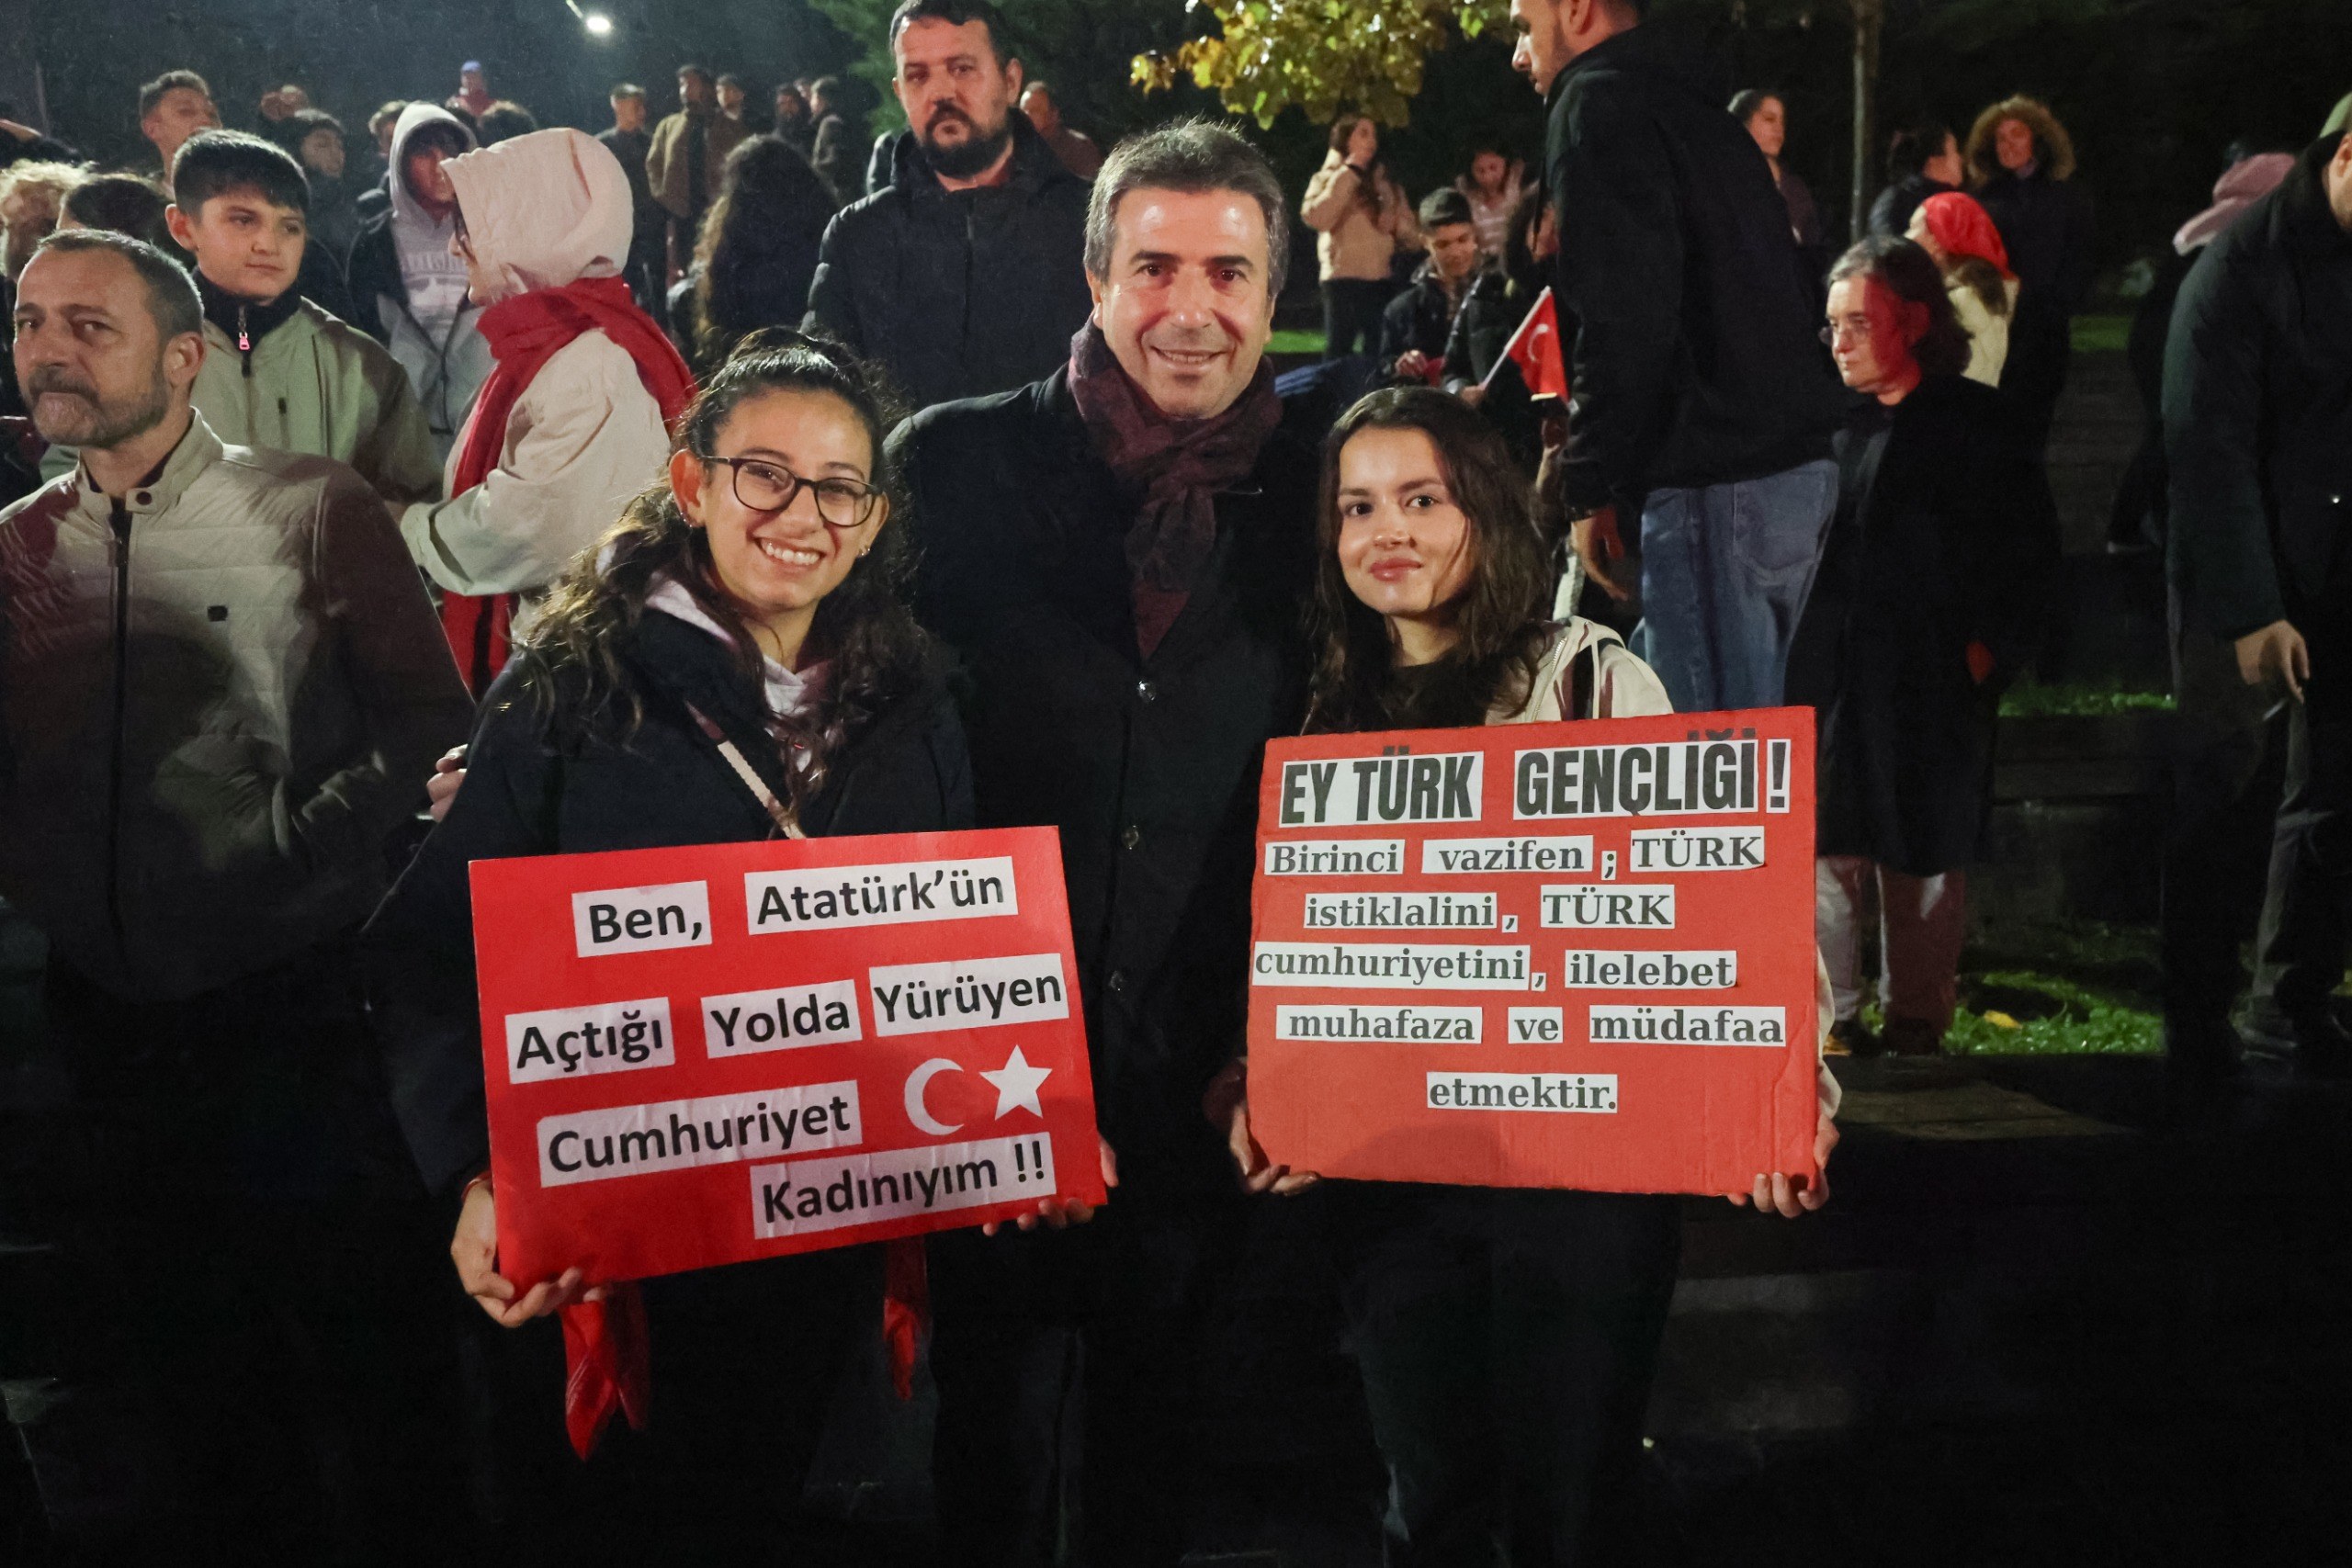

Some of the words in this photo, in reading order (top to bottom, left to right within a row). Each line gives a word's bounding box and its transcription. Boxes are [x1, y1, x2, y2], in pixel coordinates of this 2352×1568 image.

[1281, 762, 1338, 825] EY
[1352, 745, 1476, 823] TÜRK
[1271, 843, 1398, 874] Birinci
[1438, 840, 1585, 871] vazifen
[1632, 829, 1762, 868] TÜRK
[589, 903, 703, 944] Ben,
[757, 870, 1004, 925] Atatürk’ün
[1543, 886, 1672, 925] TÜRK
[1570, 953, 1734, 987] ilelebet
[515, 1008, 664, 1073] Açtığı
[709, 992, 851, 1047] Yolda
[873, 972, 1061, 1022] Yürüyen
[1289, 1008, 1476, 1041] muhafaza
[1514, 1019, 1560, 1042] ve
[1591, 1008, 1784, 1043] müdafaa
[1429, 1077, 1618, 1111] etmektir.
[548, 1095, 852, 1172] Cumhuriyet
[763, 1157, 998, 1224] Kadınıyım
